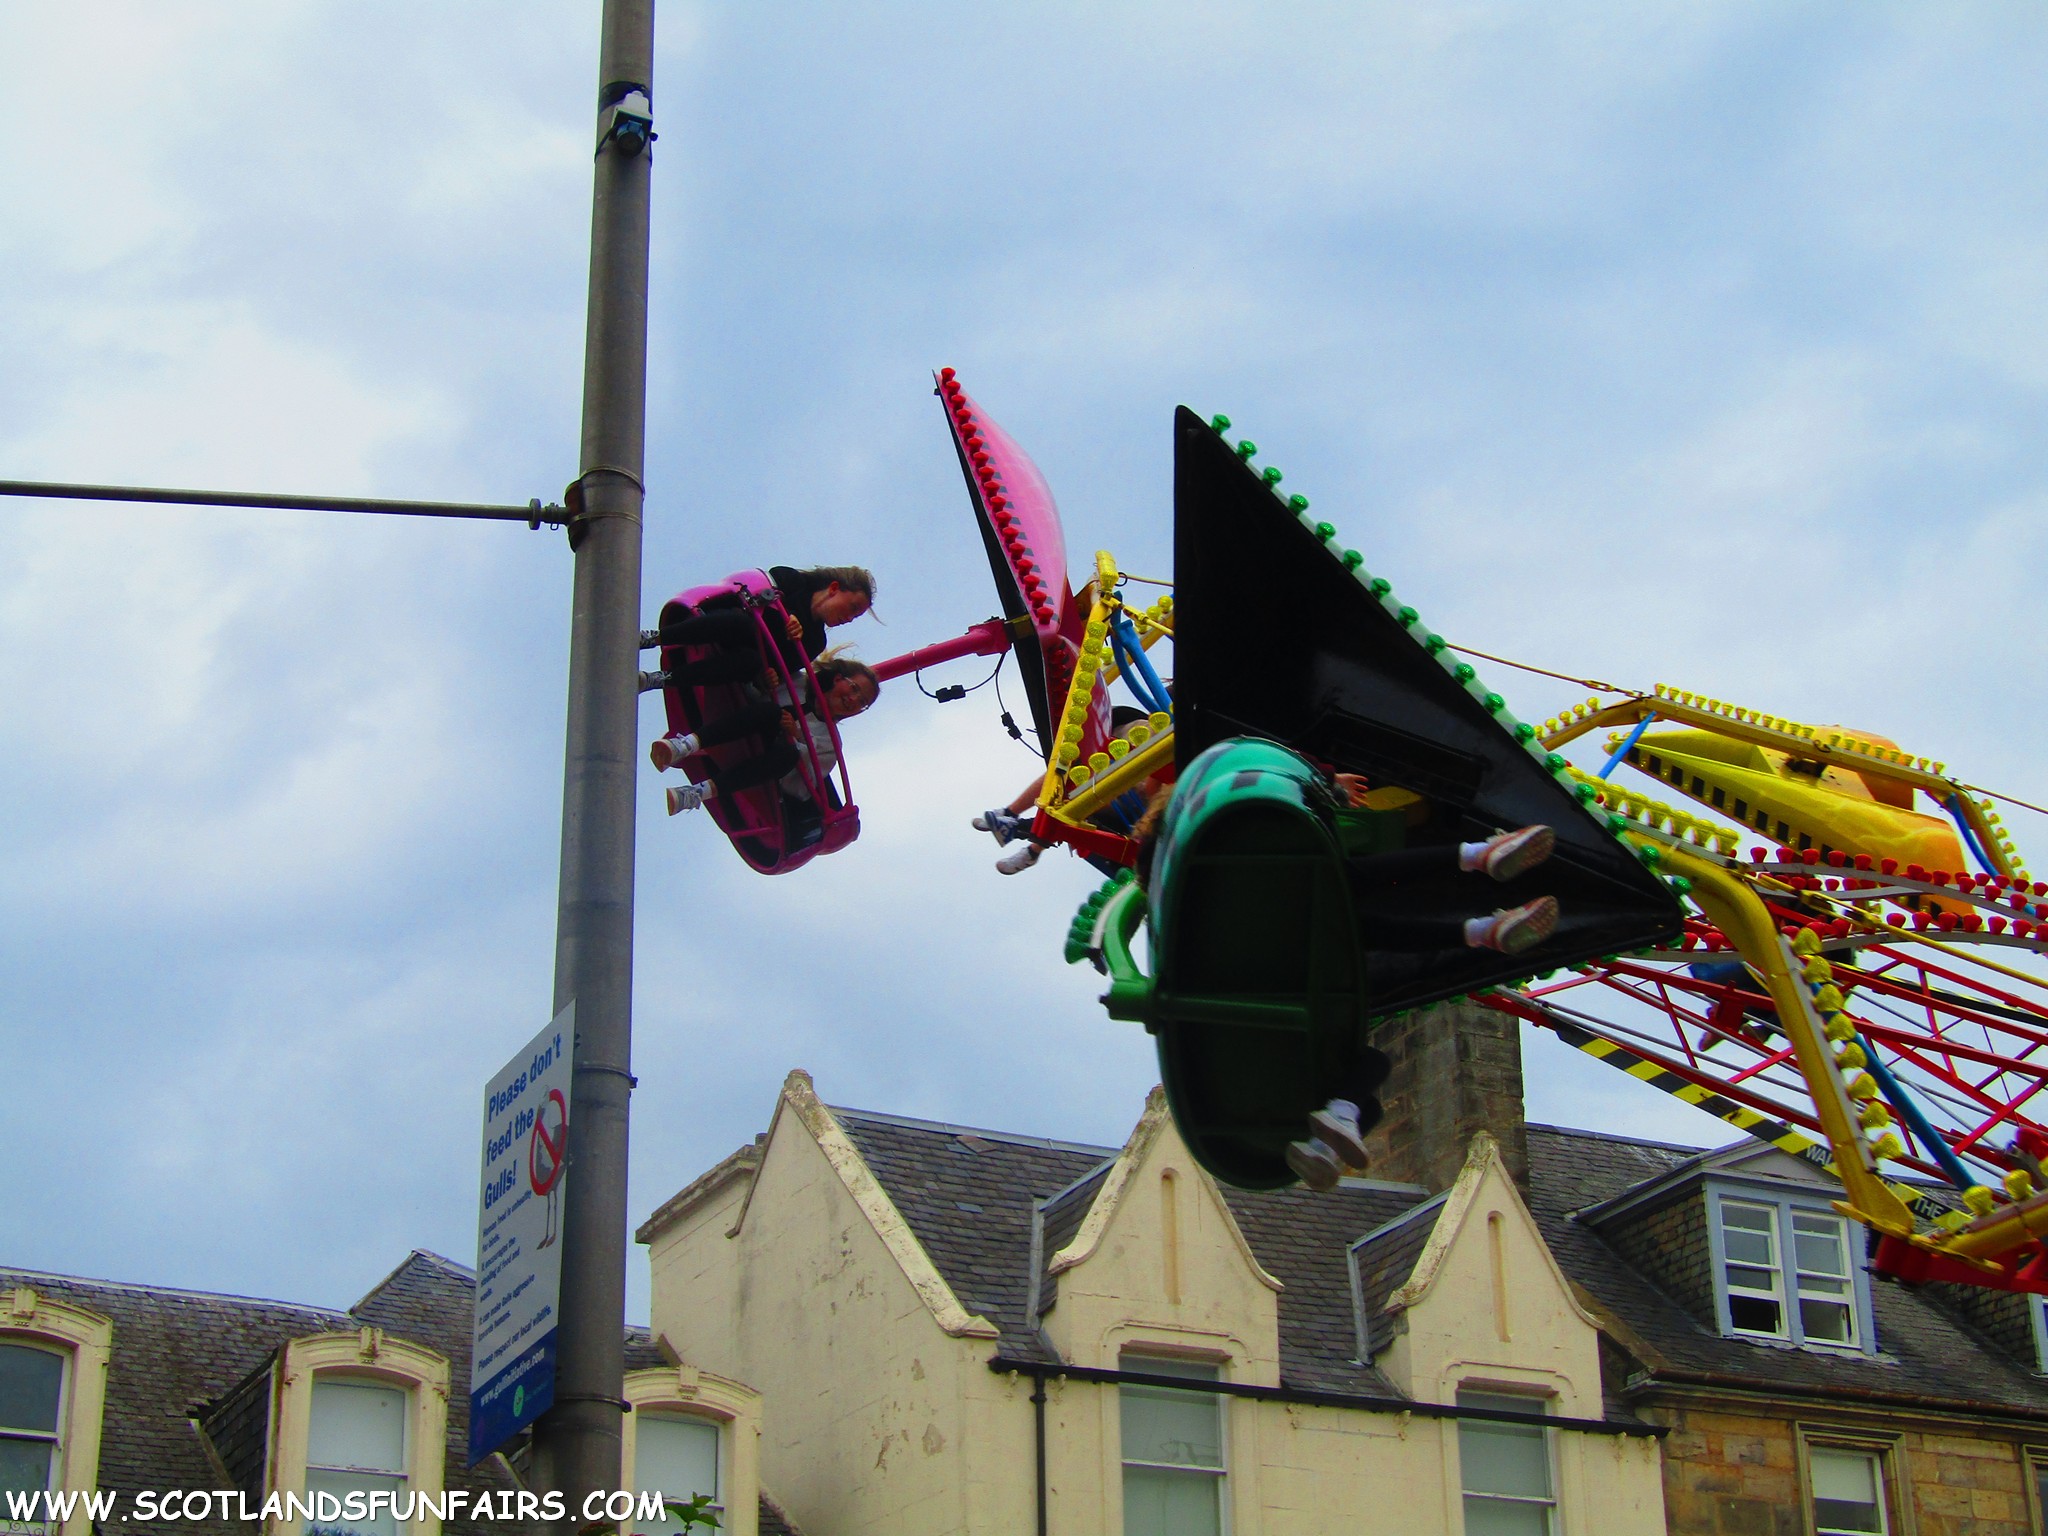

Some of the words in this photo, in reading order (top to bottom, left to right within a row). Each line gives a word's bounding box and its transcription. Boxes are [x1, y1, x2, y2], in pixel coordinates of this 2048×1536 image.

[488, 1072, 527, 1122] Please
[529, 1034, 561, 1083] don't
[486, 1121, 512, 1166] feed
[514, 1108, 534, 1140] the
[484, 1160, 517, 1209] Gulls!
[1914, 1199, 1944, 1218] THE
[484, 1243, 508, 1269] encourages
[490, 1302, 502, 1317] make
[512, 1274, 535, 1298] aggressive
[477, 1323, 494, 1343] towards
[478, 1353, 494, 1372] Please
[493, 1338, 511, 1359] respect
[520, 1318, 533, 1337] local
